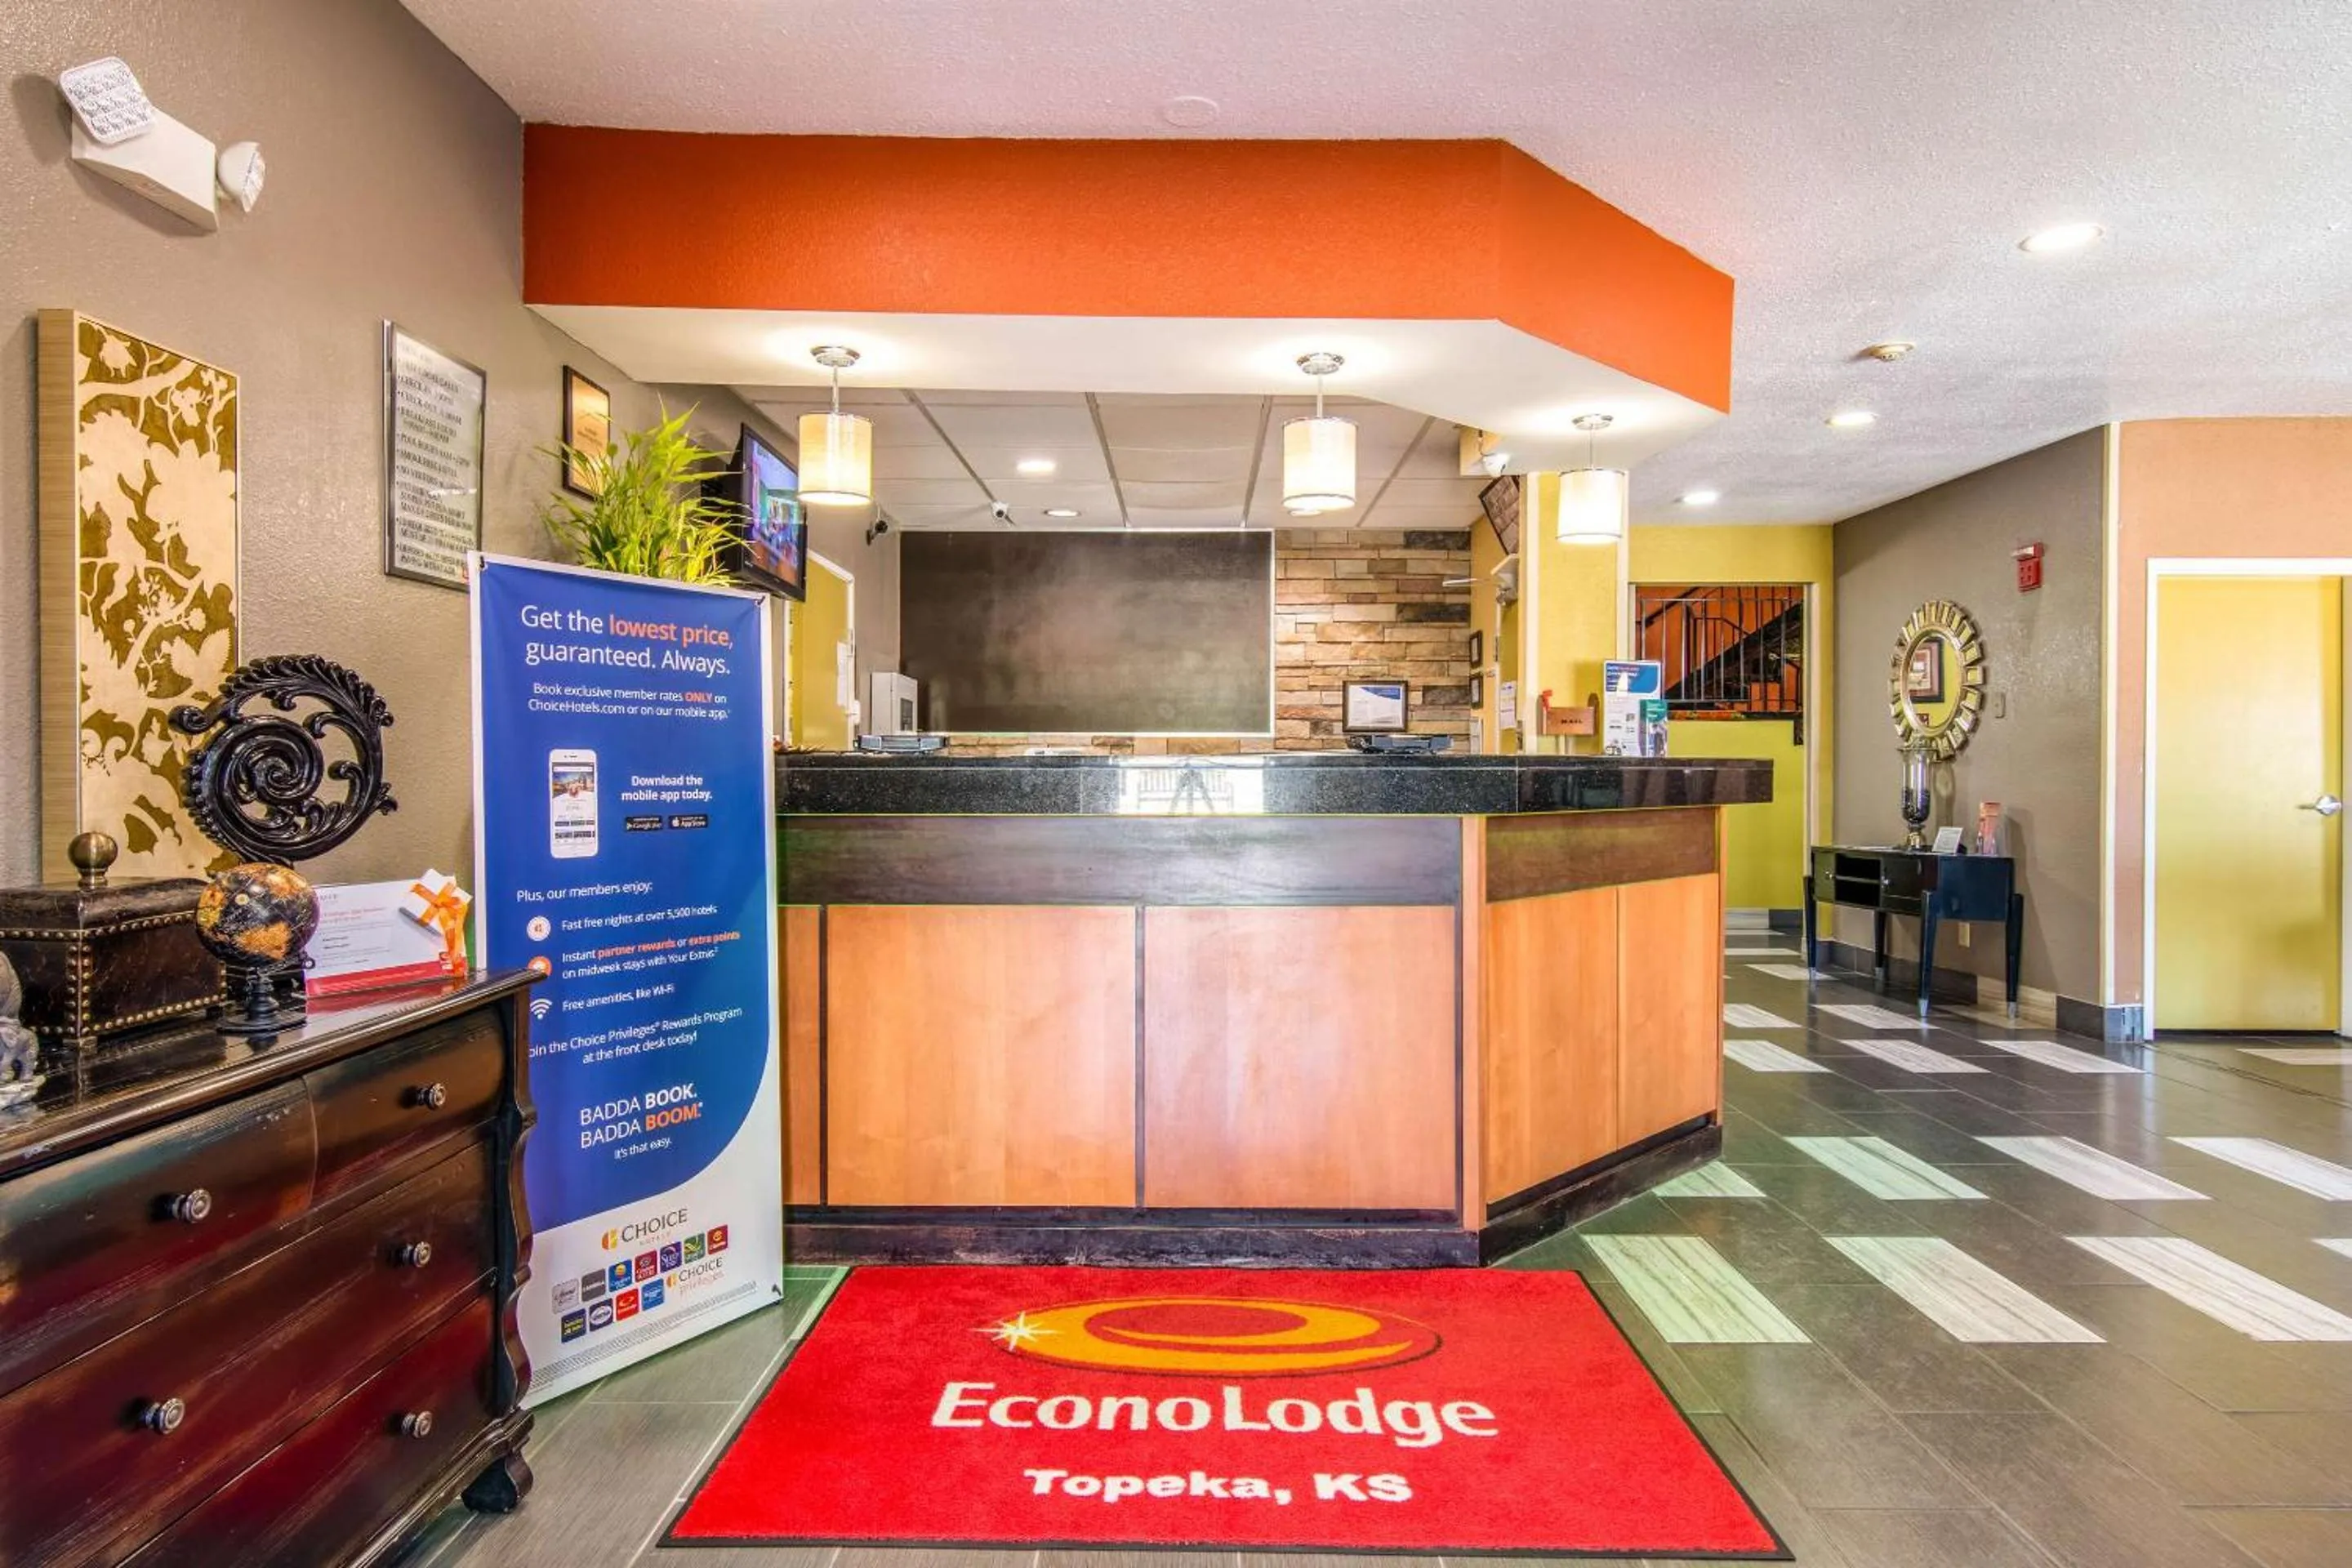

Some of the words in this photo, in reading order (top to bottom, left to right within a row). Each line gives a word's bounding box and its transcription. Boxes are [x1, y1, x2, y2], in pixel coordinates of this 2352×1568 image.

[521, 605, 562, 630] Get
[568, 609, 603, 634] the
[609, 614, 678, 641] lowest
[683, 625, 733, 649] price,
[525, 642, 657, 669] guaranteed.
[661, 649, 731, 678] Always.
[533, 683, 562, 695] Book
[564, 685, 612, 698] exclusive
[614, 688, 657, 701] member
[660, 691, 684, 702] rates
[685, 692, 713, 703] ONLY
[715, 694, 727, 703] on
[528, 698, 625, 715] ChoiceHotels.com
[627, 706, 639, 714] or
[640, 706, 654, 715] on
[657, 707, 672, 716] our
[675, 706, 706, 718] mobile
[631, 774, 684, 786] Download
[686, 775, 703, 786] the
[621, 789, 658, 801] mobile
[660, 791, 679, 803] app
[682, 789, 712, 802] today.
[517, 889, 545, 902] Plus,
[547, 889, 568, 899] our
[569, 883, 621, 898] members
[622, 881, 653, 895] enjoy:
[562, 920, 582, 931] Fast
[585, 916, 603, 928] free
[605, 913, 633, 928] nights
[635, 913, 644, 923] at
[646, 911, 665, 921] over
[562, 949, 596, 963] Instant
[598, 944, 635, 960] partner
[637, 938, 676, 952] rewards
[677, 938, 686, 947] or
[688, 935, 712, 946] extra
[562, 968, 577, 978] on
[578, 961, 621, 978] midweek
[622, 957, 645, 970] stays
[647, 954, 666, 966] with
[668, 952, 687, 963] Your
[562, 1000, 585, 1012] Free
[586, 991, 634, 1007] amenities,
[636, 987, 652, 999] like
[528, 1045, 546, 1058] oin
[549, 1040, 568, 1054] the
[570, 1033, 606, 1049] Choice
[662, 1013, 703, 1031] Rewards
[704, 1007, 743, 1022] Program
[583, 1054, 595, 1064] at
[596, 1048, 614, 1062] the
[616, 1044, 641, 1058] front
[642, 1036, 666, 1051] desk
[667, 1030, 697, 1046] today!
[580, 1096, 641, 1126] BADDA
[645, 1083, 697, 1109] BOOK.
[581, 1118, 642, 1148] BADDA
[630, 1143, 648, 1155] that
[650, 1136, 672, 1149] easy.
[621, 1208, 688, 1242] CHOICE
[679, 1257, 723, 1281] CHOICE
[930, 1382, 1499, 1447] EconoLodge
[1023, 1468, 1293, 1505] Topeka,
[1312, 1473, 1413, 1502] KS
